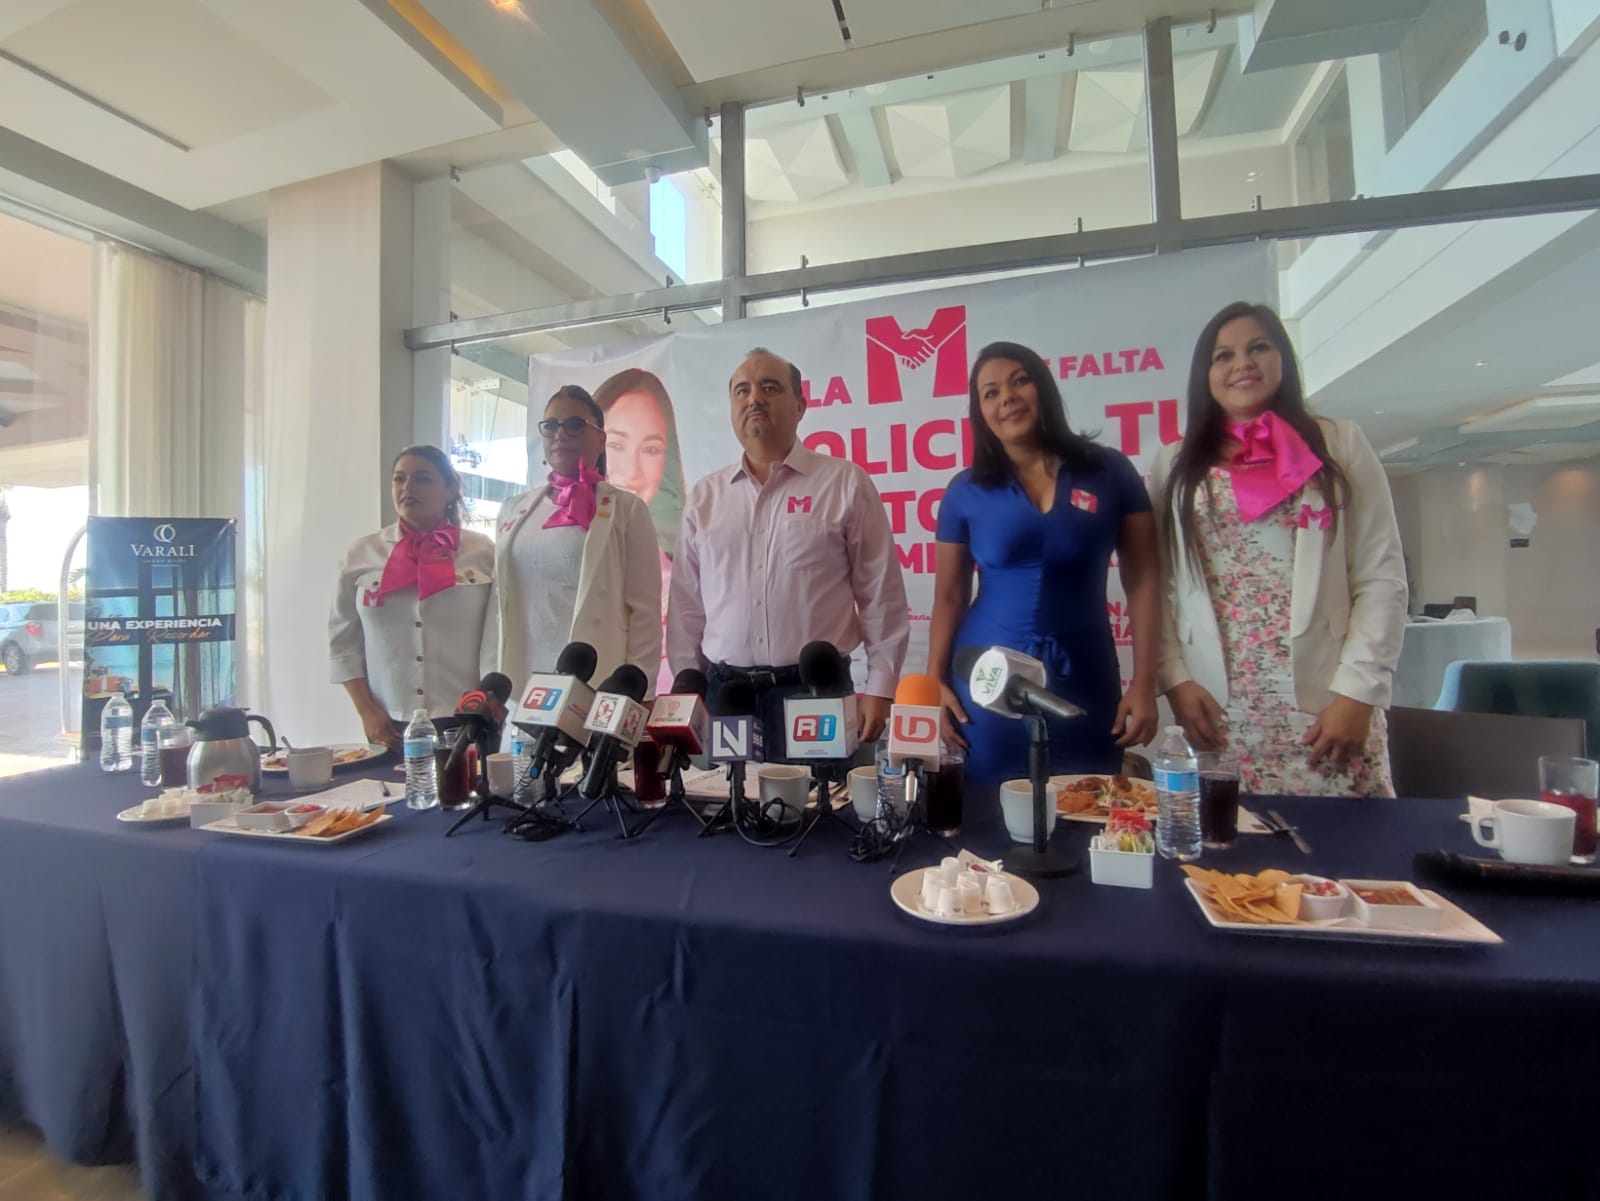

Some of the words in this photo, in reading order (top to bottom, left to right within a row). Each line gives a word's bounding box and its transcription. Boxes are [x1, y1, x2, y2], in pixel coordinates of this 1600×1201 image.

[801, 376, 852, 408] LA
[1059, 347, 1164, 380] FALTA
[787, 496, 812, 513] M
[130, 544, 196, 557] VARALI
[88, 621, 121, 631] UNA
[125, 618, 222, 630] EXPERIENCIA
